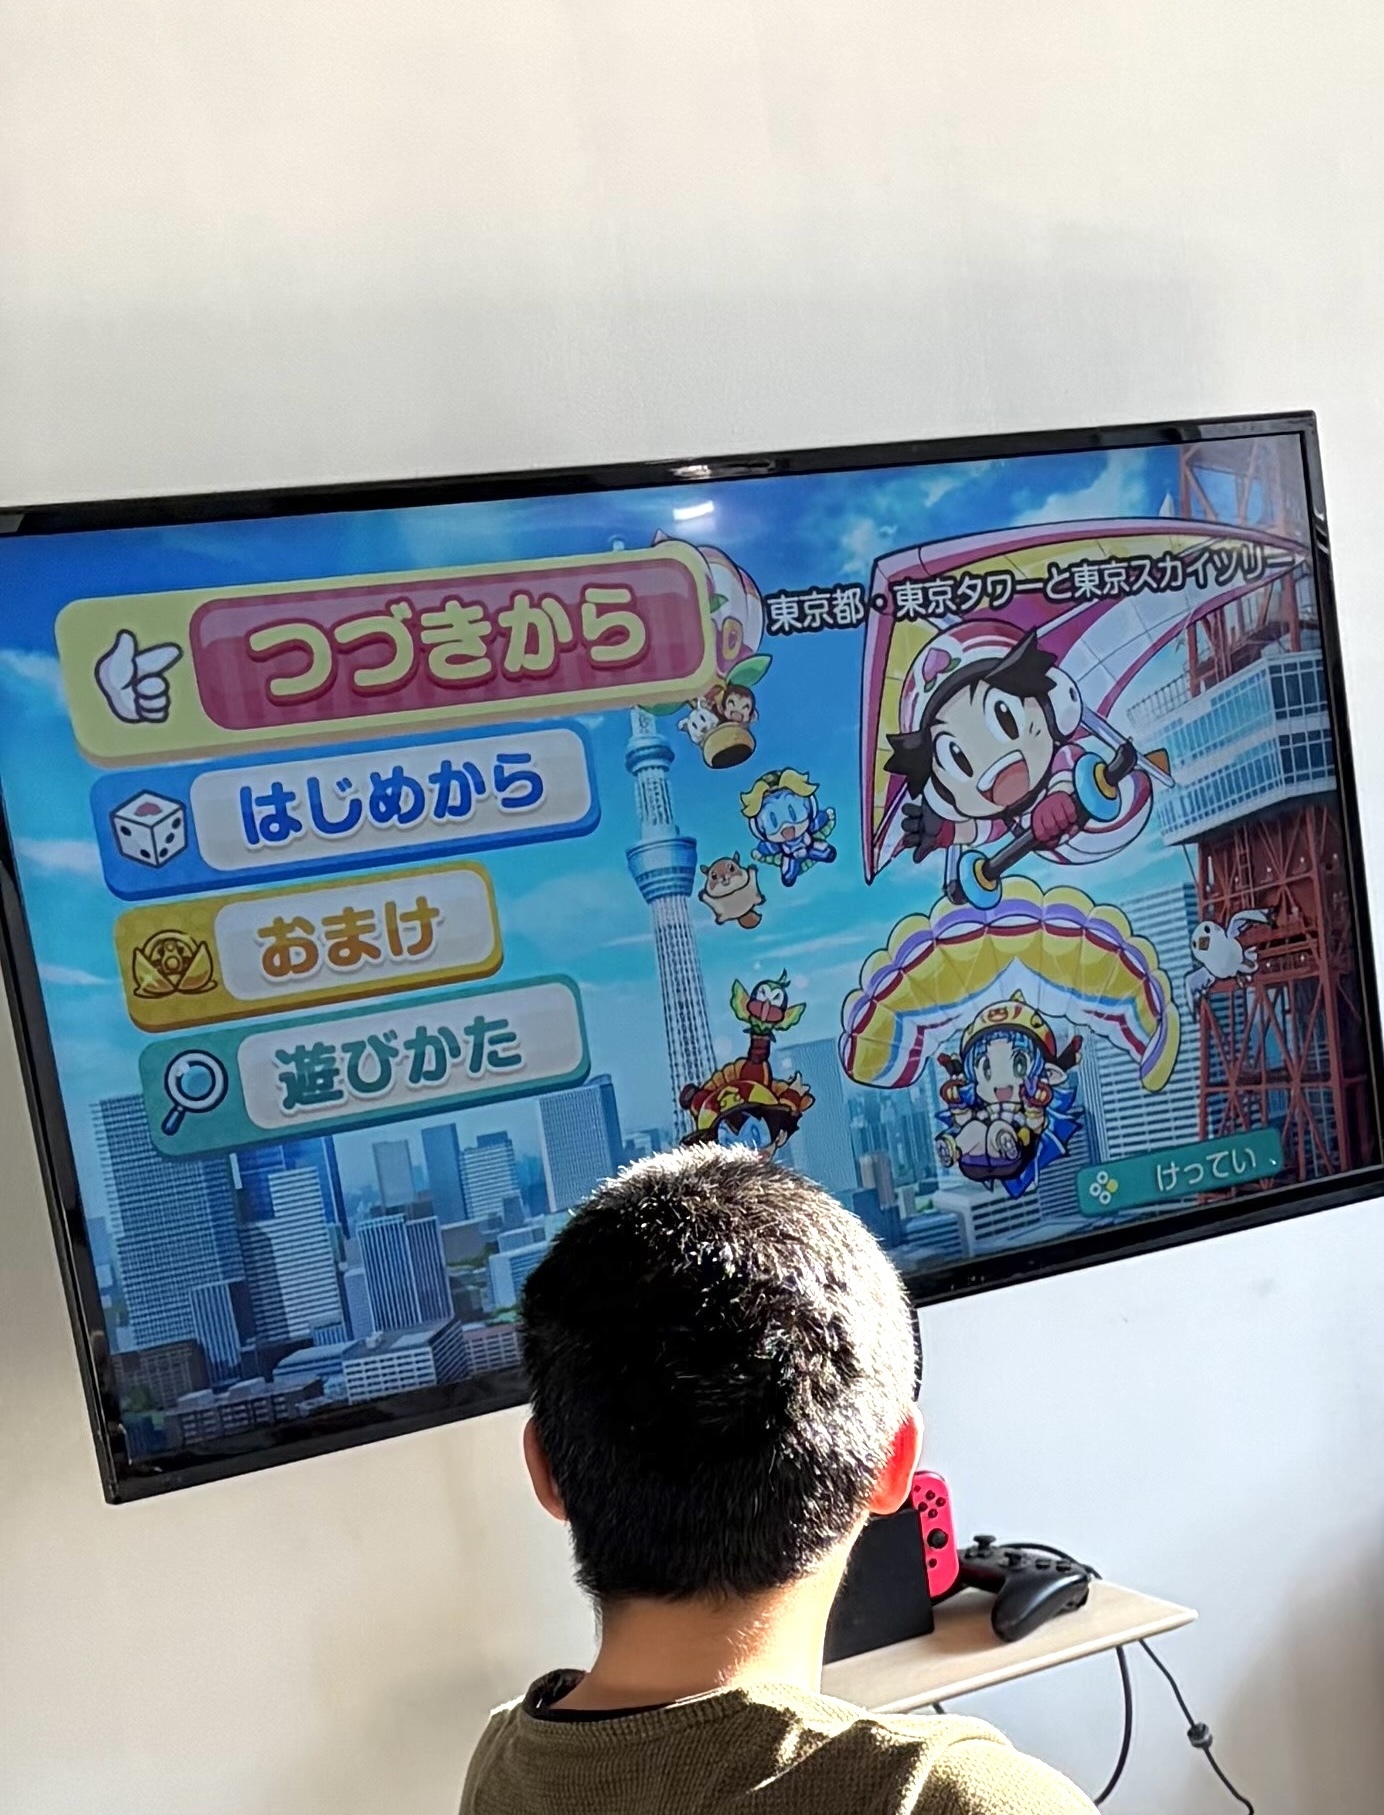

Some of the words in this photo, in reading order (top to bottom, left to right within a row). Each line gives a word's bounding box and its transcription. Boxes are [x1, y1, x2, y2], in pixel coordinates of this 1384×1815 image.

[249, 588, 646, 697] つづきから
[240, 753, 544, 845] はじめから
[257, 896, 440, 976] おまけ
[275, 1015, 522, 1110] 遊びかた
[1156, 1148, 1257, 1192] けってい
